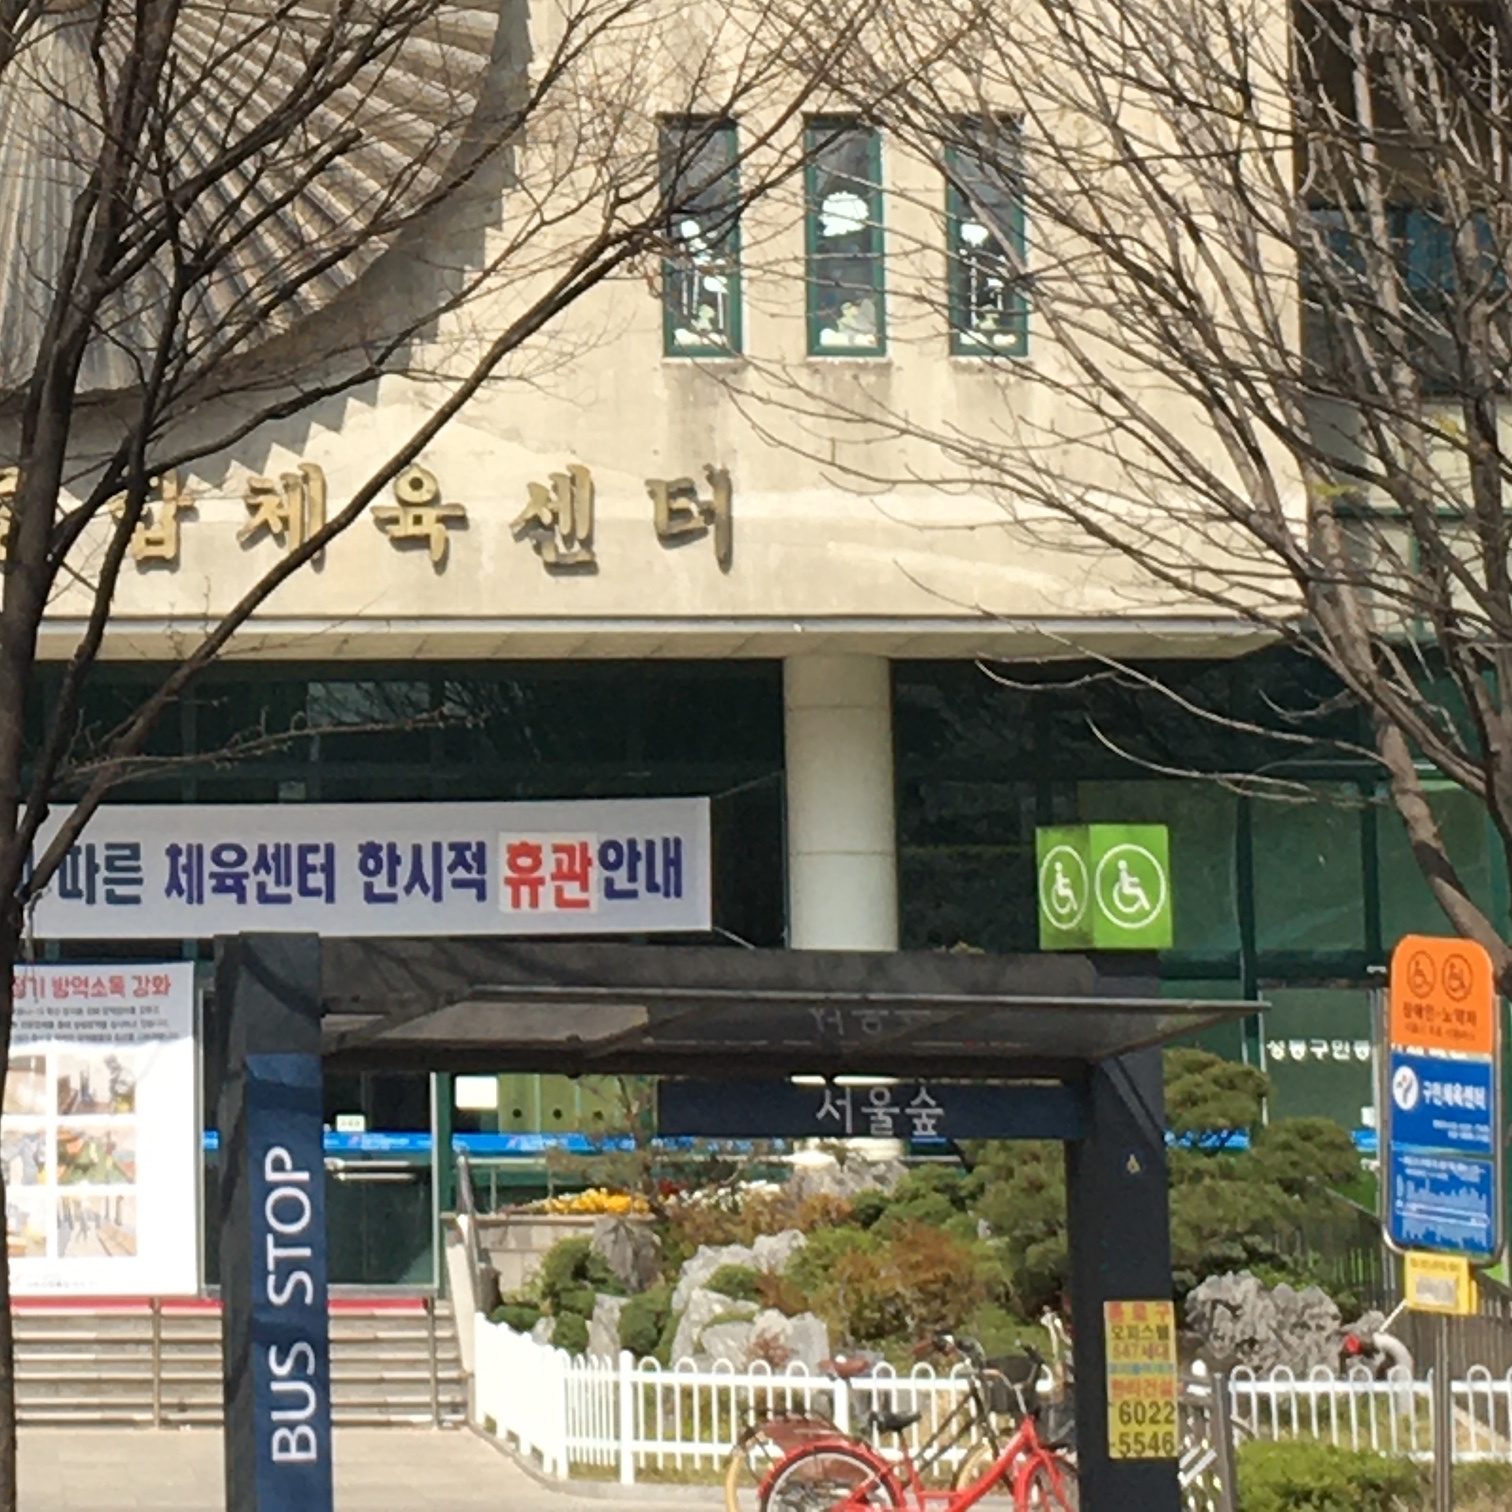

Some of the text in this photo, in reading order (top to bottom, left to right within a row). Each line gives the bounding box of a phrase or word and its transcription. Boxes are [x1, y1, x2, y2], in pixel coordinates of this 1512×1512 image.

[58, 841, 144, 905] 따른
[164, 842, 336, 906] 체육센터
[357, 840, 488, 905] 한시적
[816, 1087, 946, 1135] 서울숲
[264, 1146, 318, 1464] BUS STOP
[1118, 1400, 1176, 1426] 6022
